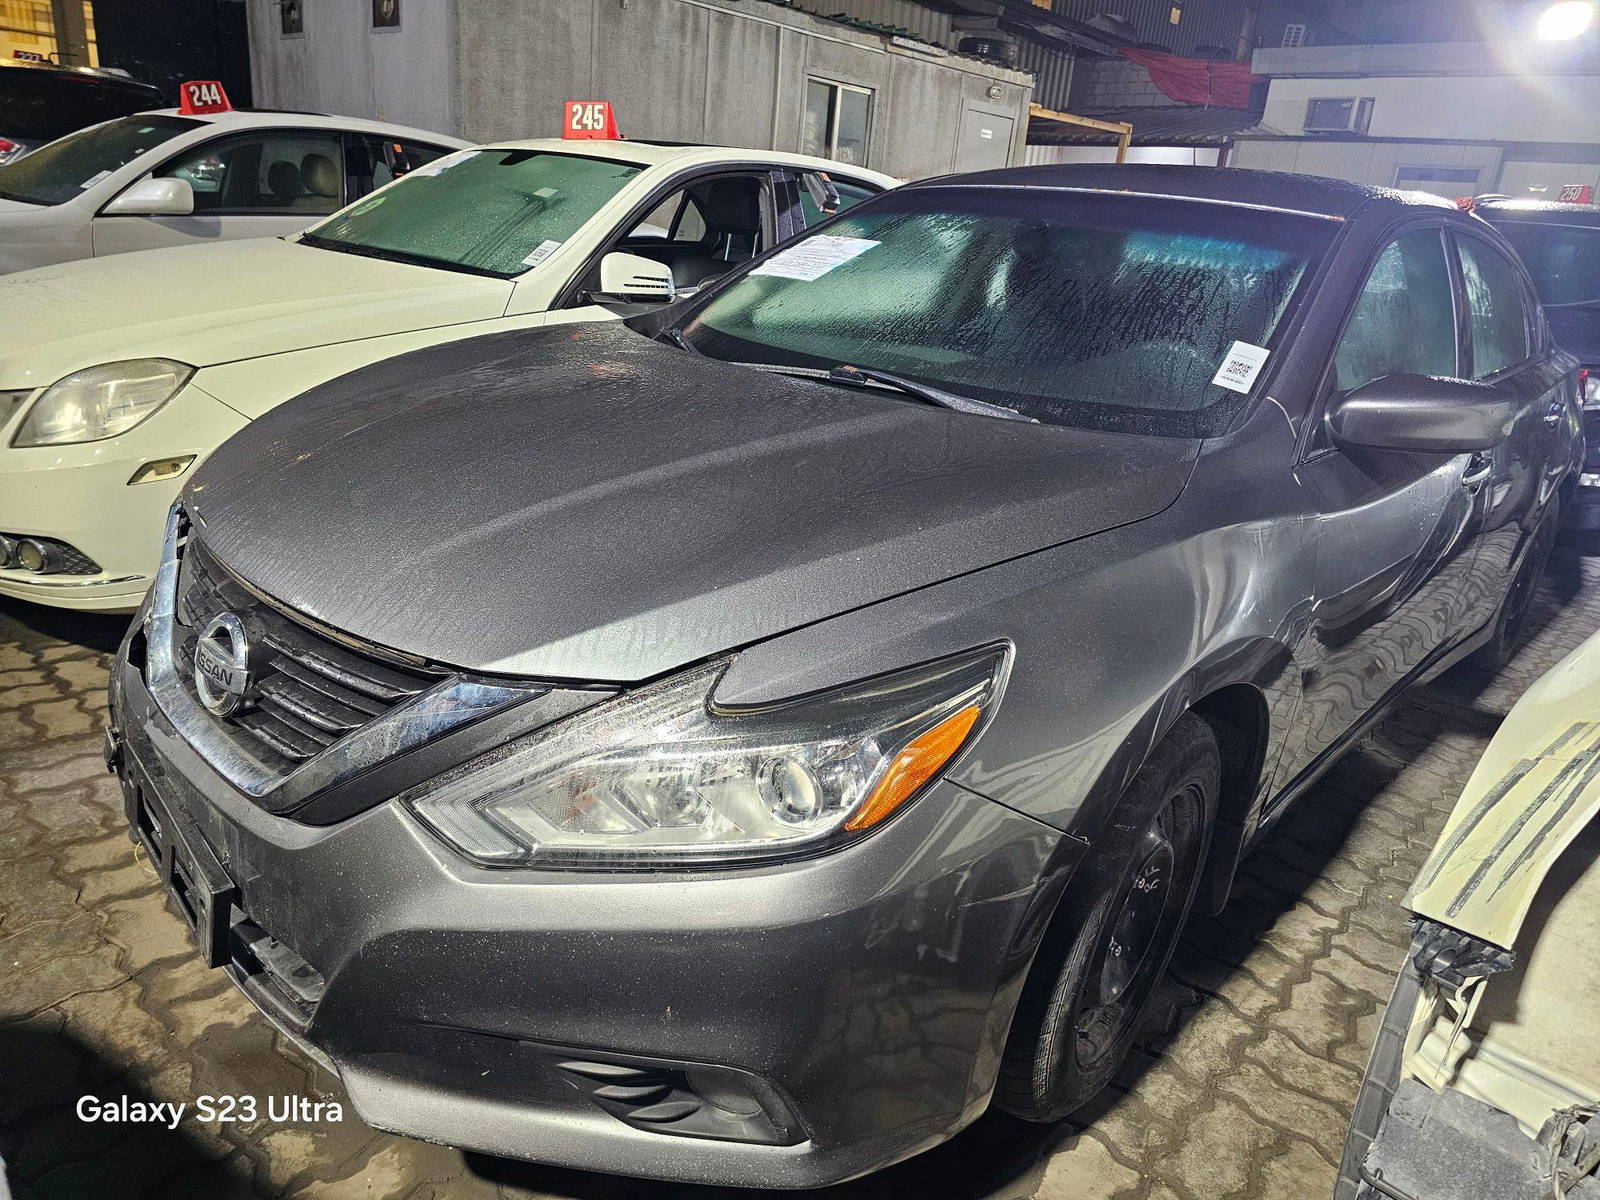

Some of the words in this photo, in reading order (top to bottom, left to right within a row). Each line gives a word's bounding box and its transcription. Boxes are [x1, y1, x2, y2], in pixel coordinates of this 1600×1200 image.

[190, 84, 221, 106] 244
[572, 104, 604, 130] 245
[1560, 187, 1582, 201] 250
